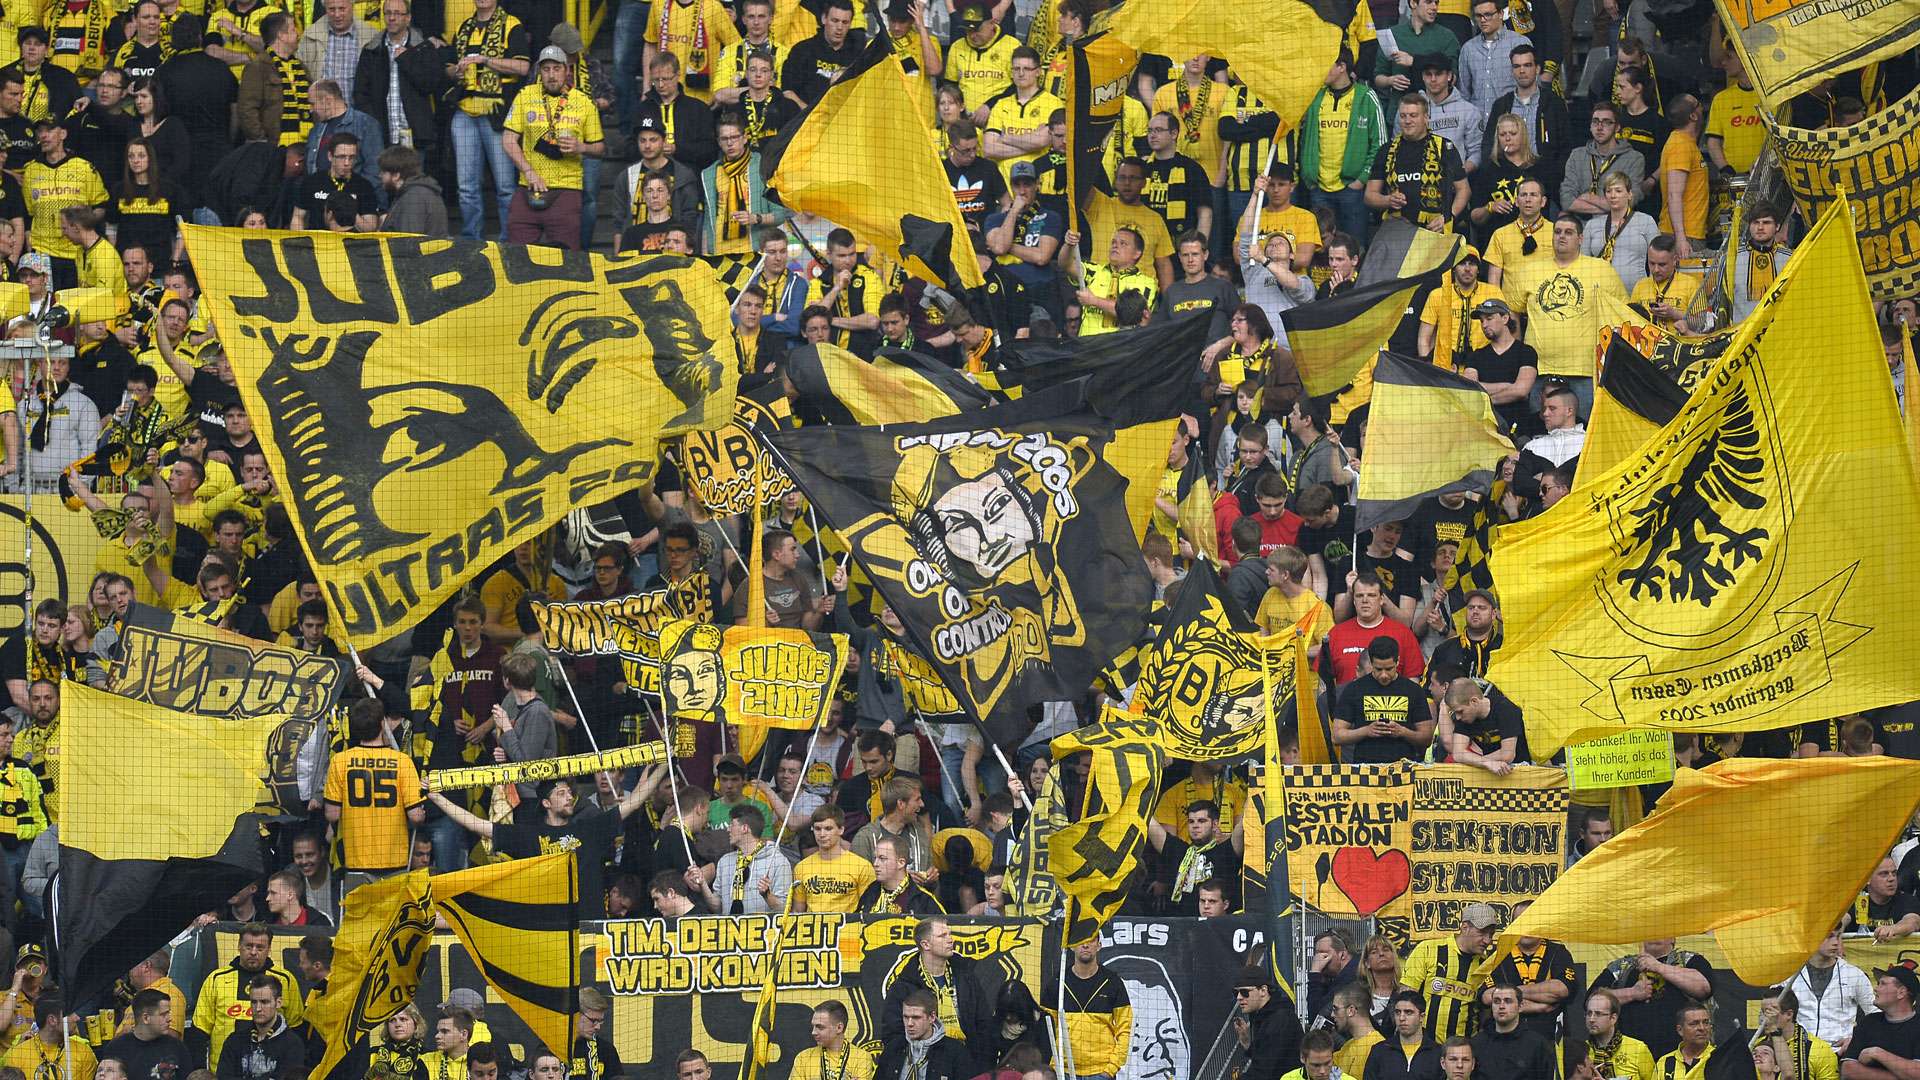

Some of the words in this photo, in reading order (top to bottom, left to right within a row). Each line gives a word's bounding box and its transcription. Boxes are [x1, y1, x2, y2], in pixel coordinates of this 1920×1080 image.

[1841, 2, 1876, 20] WIR
[962, 71, 1004, 79] EVONIK
[1786, 142, 1835, 167] Unity
[1788, 127, 1920, 196] EKTION
[40, 188, 81, 197] EVONIK
[1025, 234, 1039, 247] 87
[688, 430, 755, 481] BVB
[325, 487, 546, 636] ULTRAS
[107, 626, 343, 720] JUBOS
[730, 642, 831, 684] JUBOS
[741, 680, 821, 720] 2005
[1382, 713, 1408, 722] UNITY
[1629, 733, 1643, 745] Ihr
[1645, 730, 1669, 744] Wohl
[347, 757, 398, 769] JUBOS
[1575, 754, 1597, 767] steht
[1600, 751, 1629, 765] höher,
[1632, 749, 1646, 762] als
[1649, 748, 1666, 760] das
[346, 768, 399, 808] 05
[1592, 771, 1613, 783] Ihrer
[1616, 768, 1656, 782] Kunden!
[1288, 791, 1311, 802] FÜR
[1314, 790, 1352, 802] IMMER
[1285, 821, 1392, 851] STADION
[1412, 820, 1562, 855] SEKTION
[808, 875, 854, 889] WESTFALEN
[1412, 860, 1558, 895] STADION
[812, 886, 850, 895] STADION
[605, 918, 673, 958] TIM,
[678, 916, 768, 954] DEINE
[775, 912, 844, 948] ZEIT
[606, 955, 692, 993] WIRD
